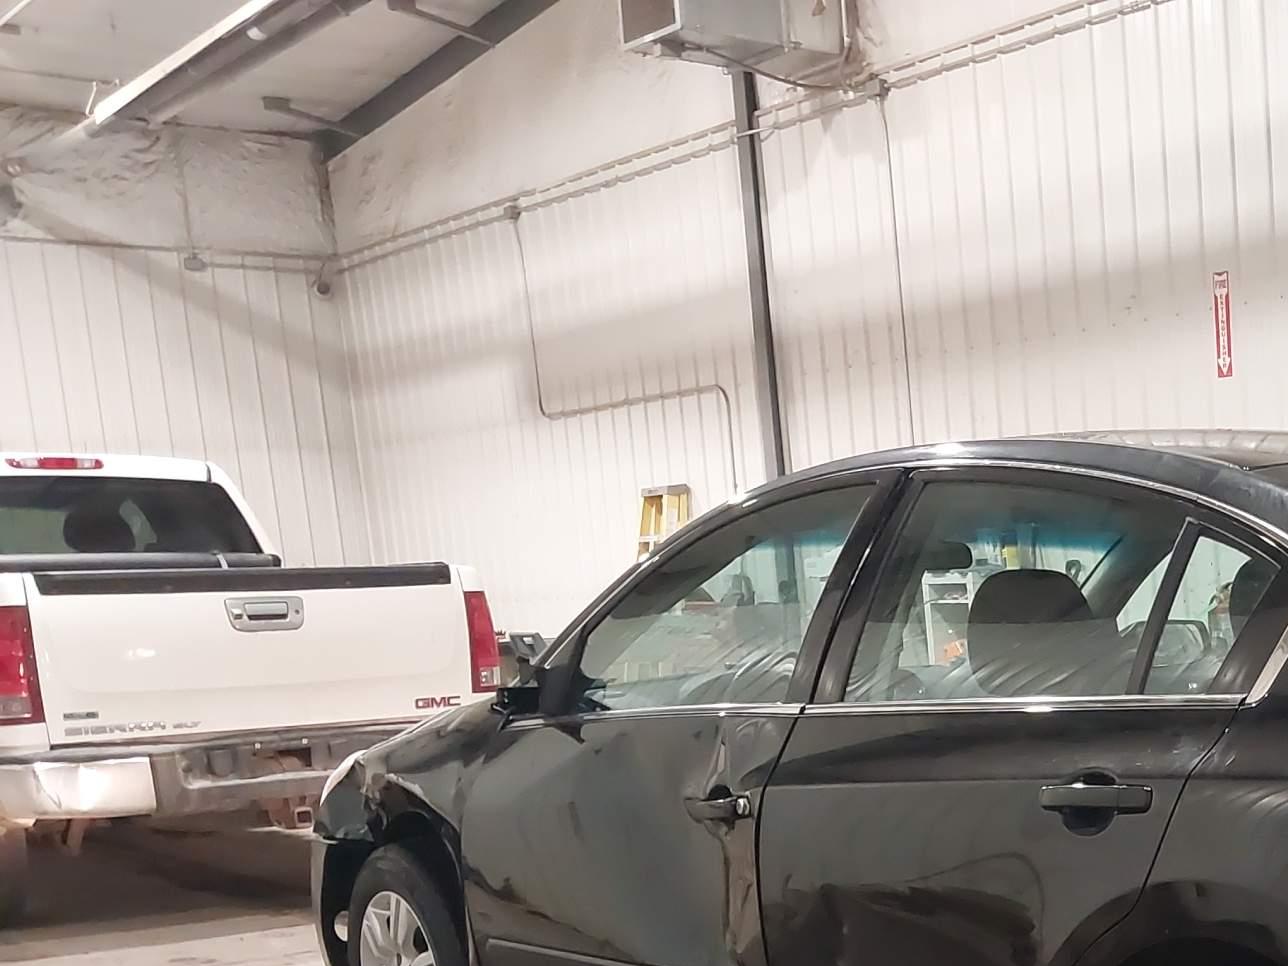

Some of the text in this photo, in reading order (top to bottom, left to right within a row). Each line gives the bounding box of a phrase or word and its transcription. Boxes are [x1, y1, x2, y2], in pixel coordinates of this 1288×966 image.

[1215, 279, 1227, 289] FIRE
[1219, 294, 1227, 369] EXTINGUISHER
[415, 696, 461, 709] GMC
